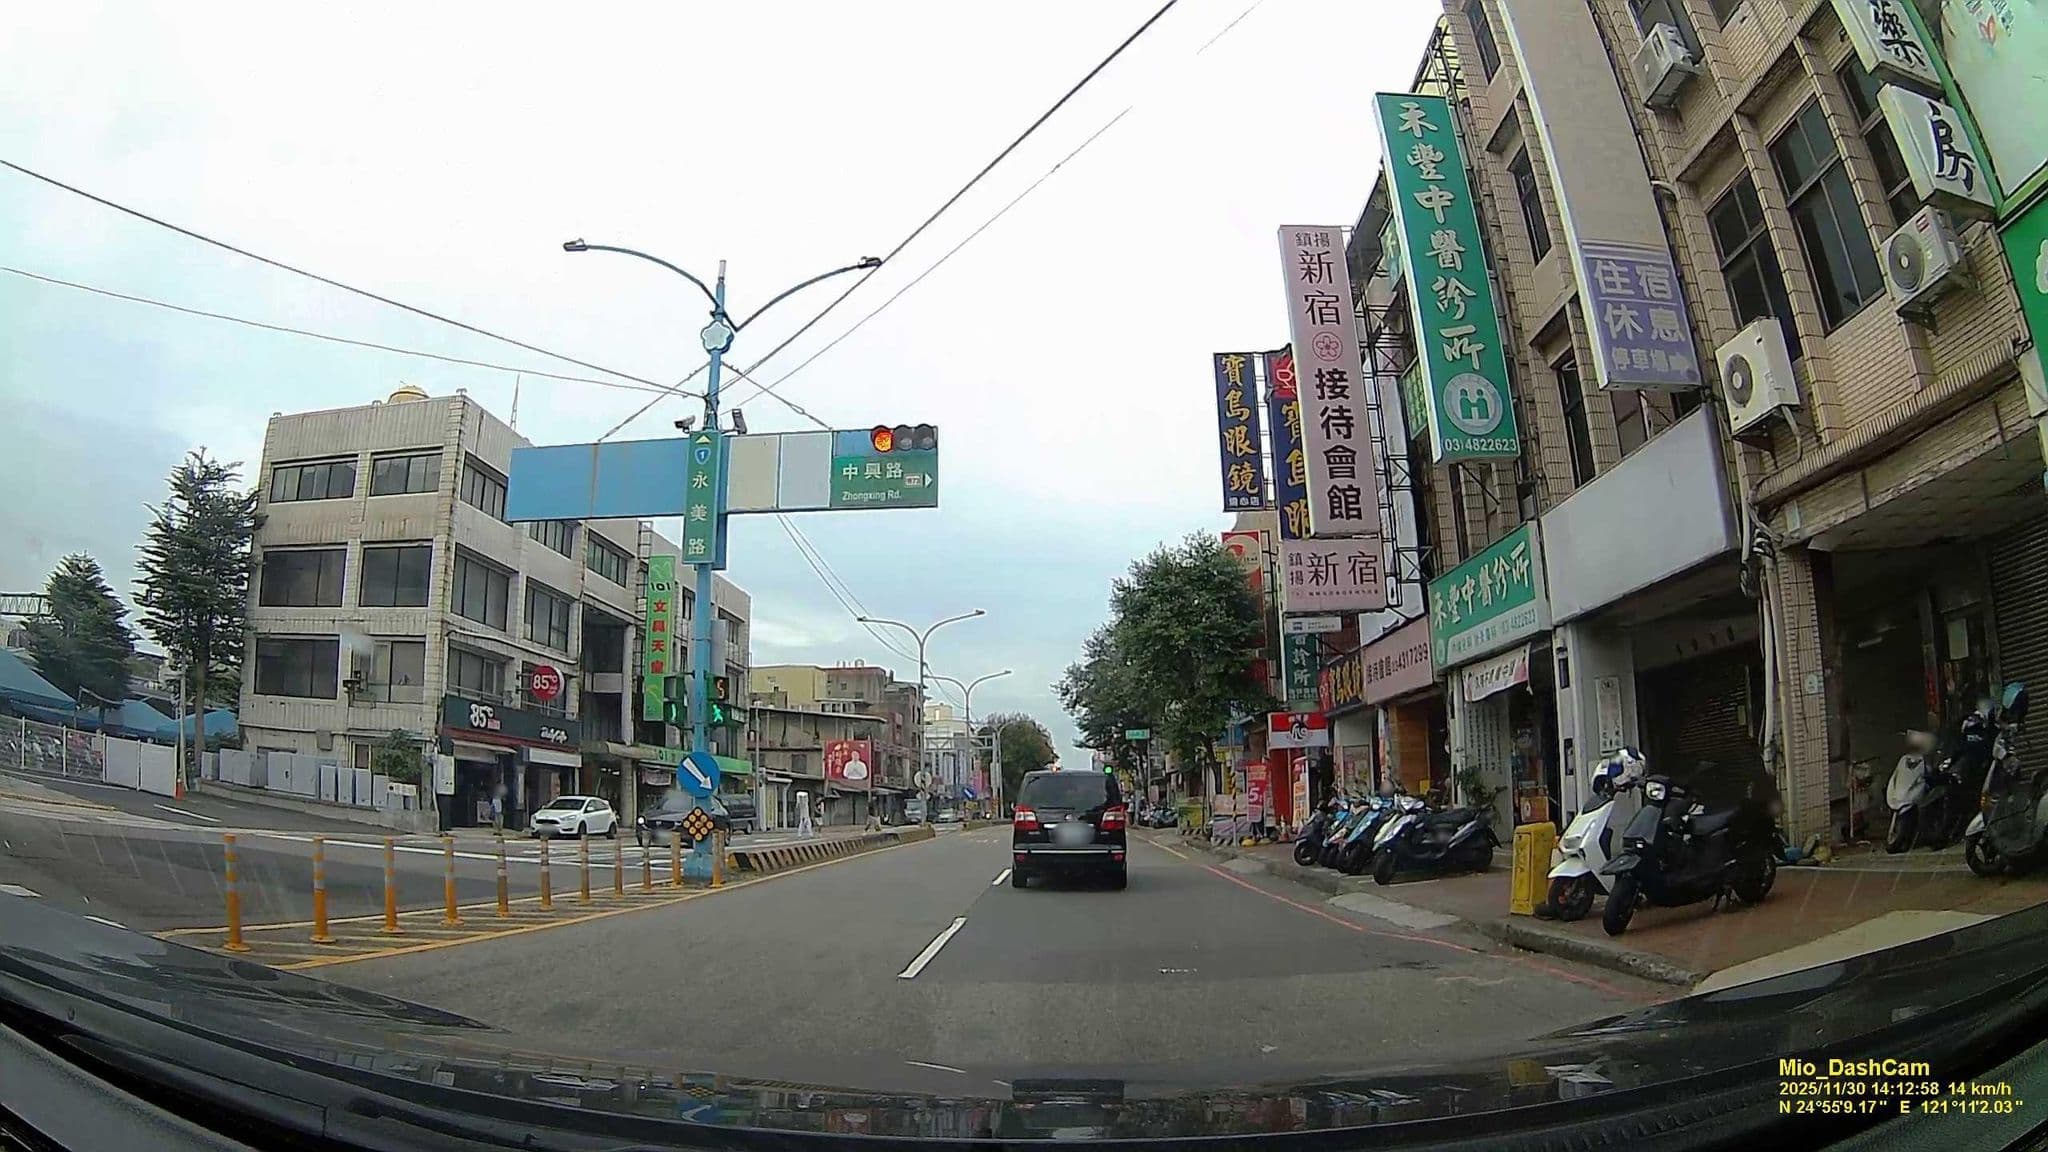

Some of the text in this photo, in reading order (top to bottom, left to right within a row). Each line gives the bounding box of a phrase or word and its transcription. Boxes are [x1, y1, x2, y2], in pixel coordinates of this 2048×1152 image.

[1398, 101, 1494, 371] 禾豐中醫診所
[1298, 249, 1341, 326] 新宿
[1594, 260, 1673, 299] 住宿
[1604, 302, 1685, 341] 休息
[1221, 354, 1259, 495] 寶島眼鏡
[1314, 367, 1363, 522] 接待會館
[1442, 438, 1517, 452] (03)4822623
[842, 462, 904, 481] 中興路
[688, 471, 710, 556] 永美路
[842, 489, 902, 503] Zhongxing Rd.
[650, 582, 672, 592] 101
[1307, 550, 1379, 587] 新宿
